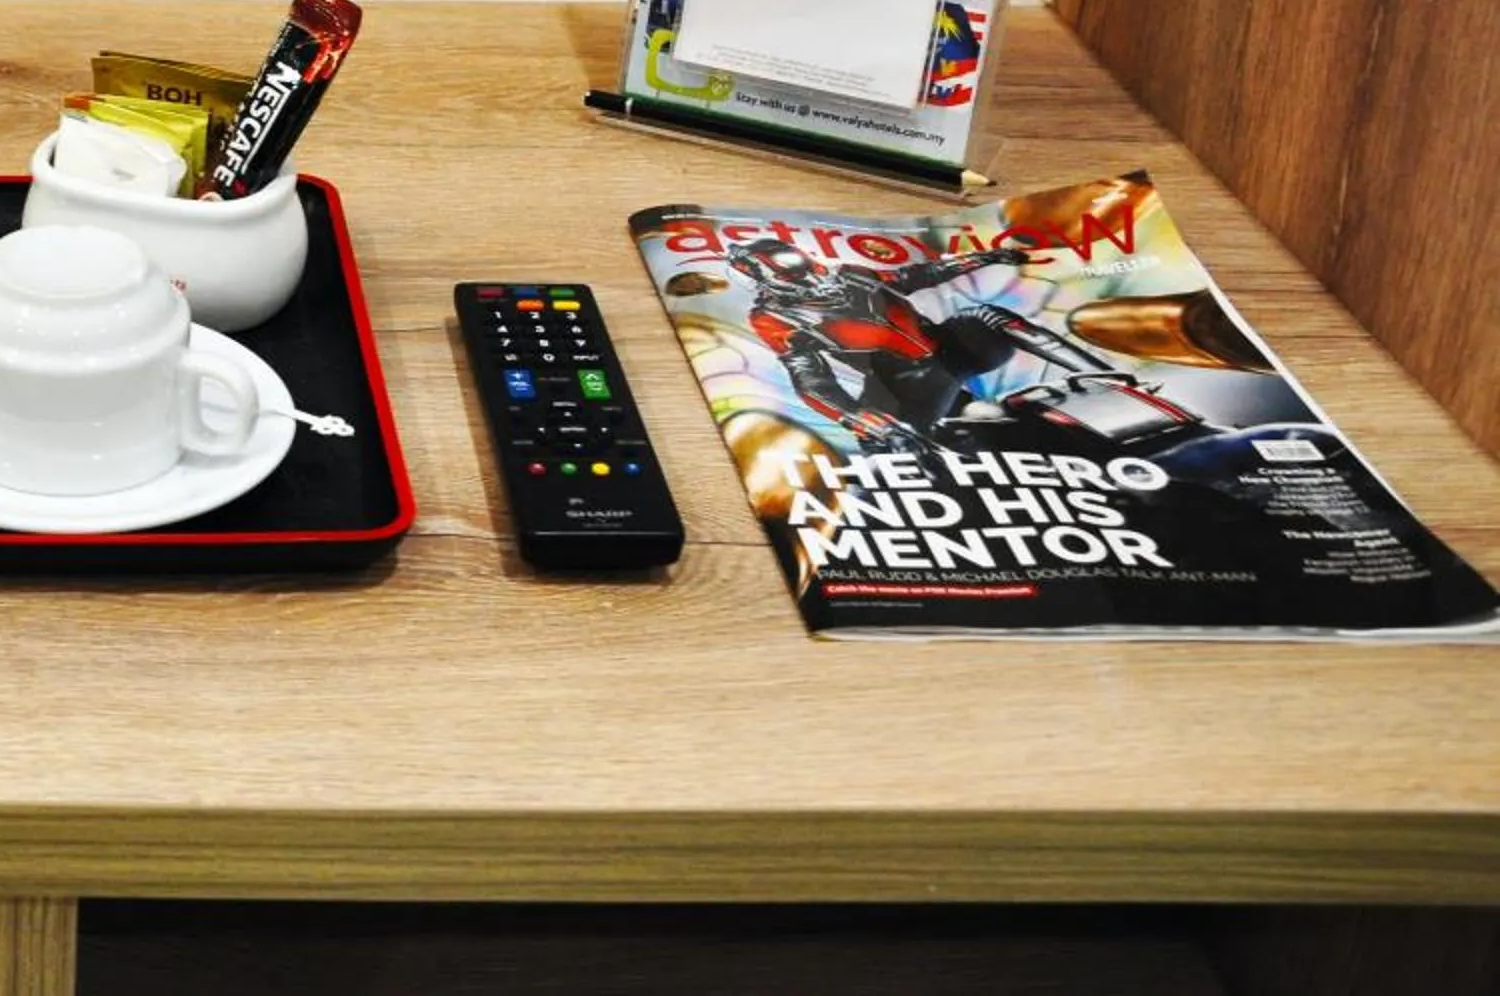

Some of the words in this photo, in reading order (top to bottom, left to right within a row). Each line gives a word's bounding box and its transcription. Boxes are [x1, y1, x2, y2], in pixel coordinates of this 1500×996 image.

[146, 83, 203, 106] BOH
[735, 91, 757, 107] Stay
[759, 95, 782, 113] with
[784, 102, 797, 114] us
[780, 452, 932, 490] THE
[942, 450, 1170, 491] HERO
[788, 490, 963, 528] AND
[983, 488, 1126, 527] HIS
[796, 524, 1175, 569] MENTOR
[817, 568, 861, 581] PAUL
[867, 569, 921, 582] RUDD
[925, 571, 939, 582] &
[941, 569, 1022, 582] MICHAEL
[1026, 567, 1119, 581] DOUGLAS
[1121, 567, 1165, 580] TALK
